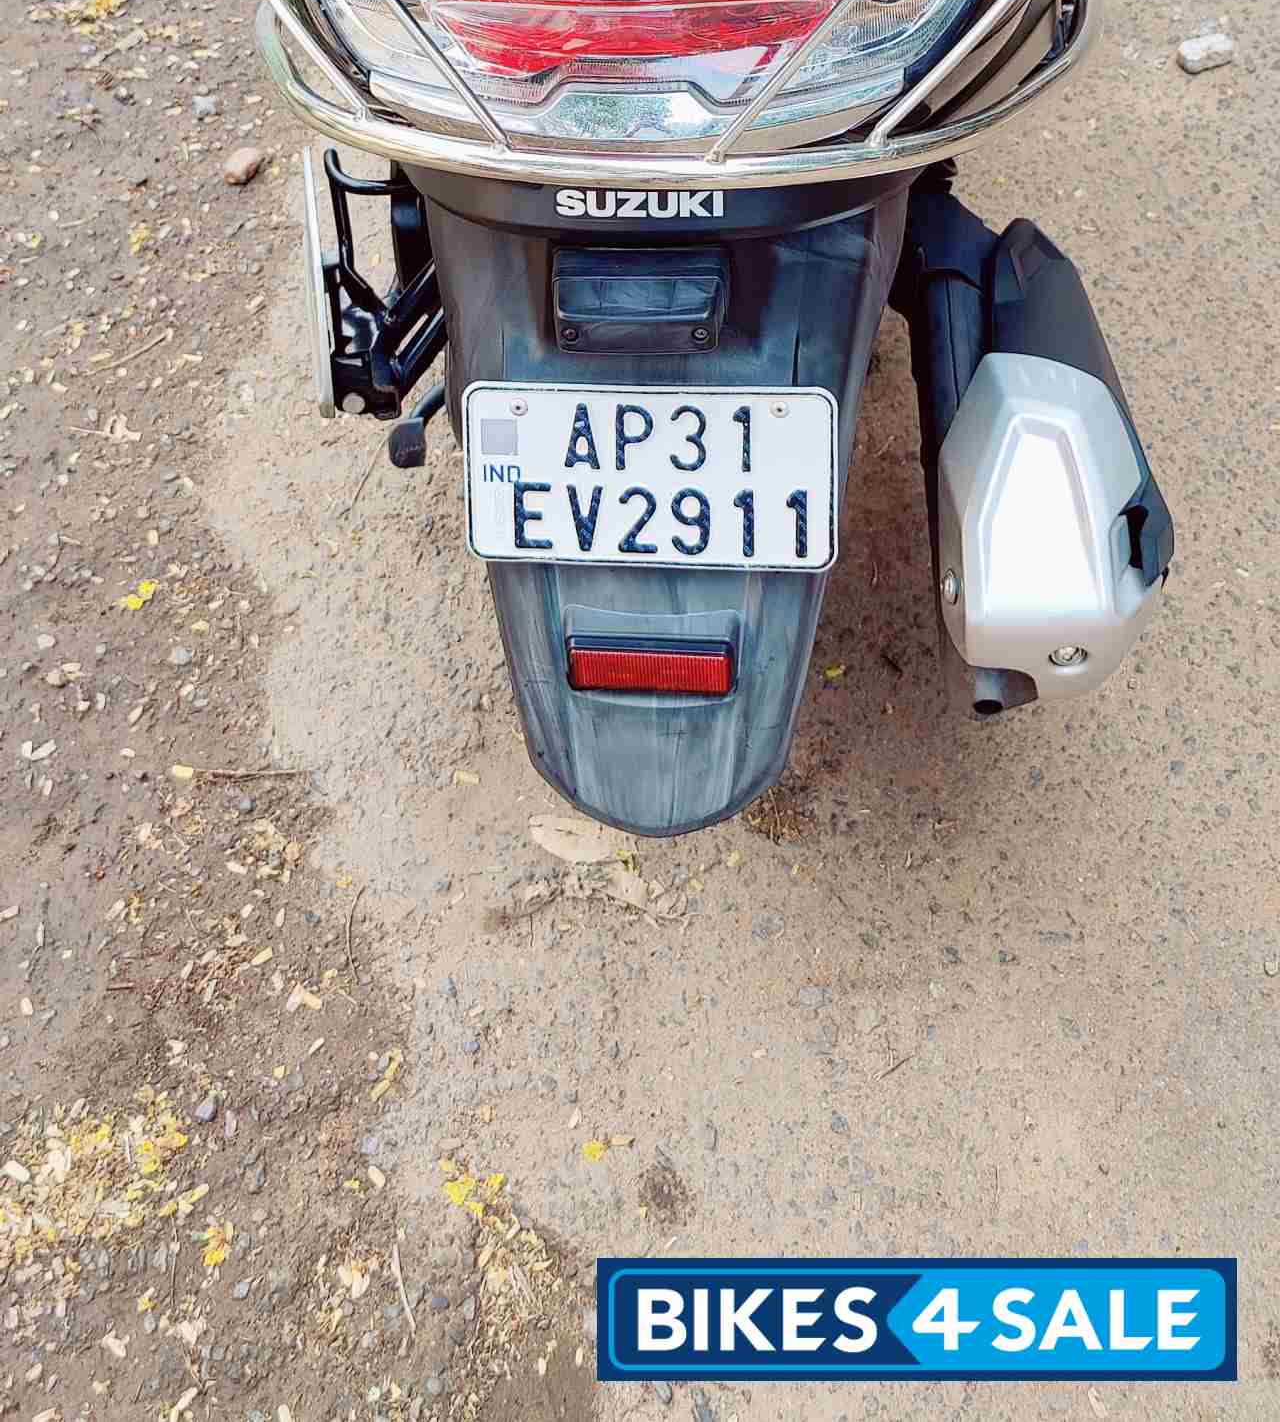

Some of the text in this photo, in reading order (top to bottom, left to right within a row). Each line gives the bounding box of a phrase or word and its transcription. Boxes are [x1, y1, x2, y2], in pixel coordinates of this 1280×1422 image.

[556, 189, 725, 218] SUZUKI
[564, 403, 753, 472] AP31
[483, 463, 521, 484] IND
[513, 482, 809, 559] EV2911
